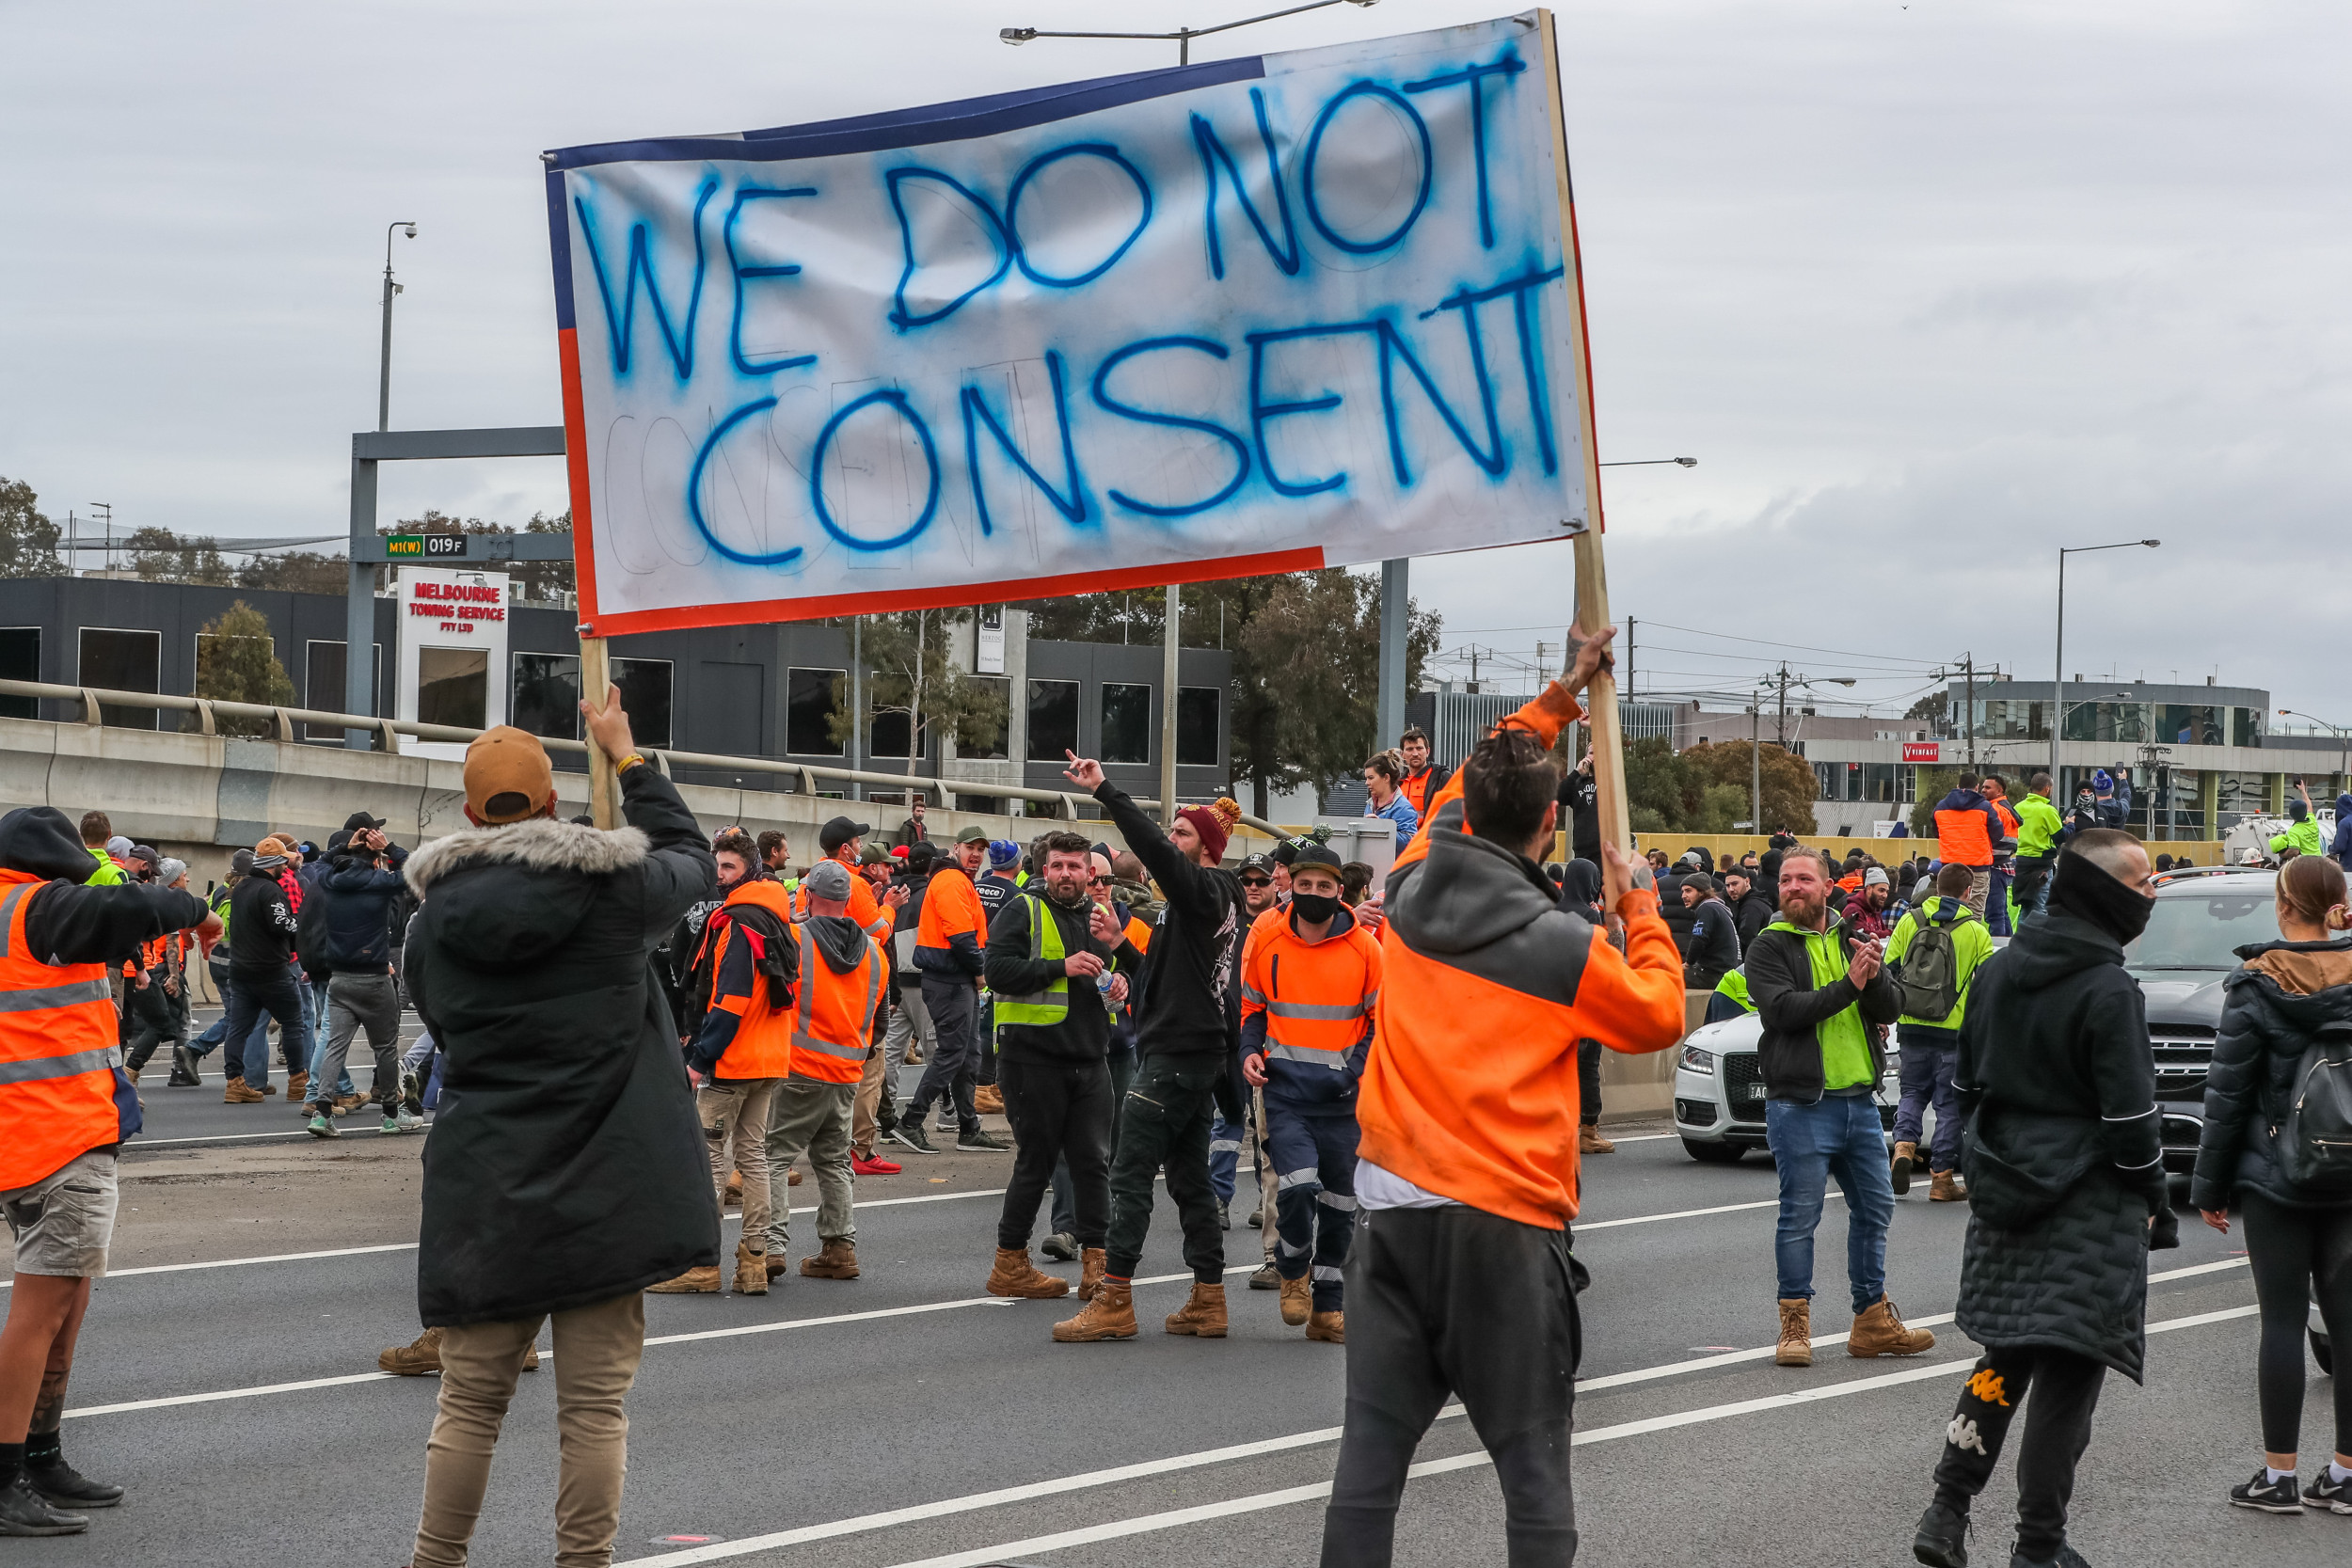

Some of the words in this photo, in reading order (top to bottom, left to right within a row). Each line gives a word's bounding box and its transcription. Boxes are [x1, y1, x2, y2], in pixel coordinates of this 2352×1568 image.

[573, 179, 818, 380] WE
[884, 142, 1154, 332] DO
[1190, 47, 1527, 280] NOT
[689, 261, 1565, 566] CONSENT
[389, 540, 421, 553] M1(W)
[415, 582, 500, 603] MELBOURNE
[409, 603, 454, 617] TOWING
[457, 605, 504, 621] SERVICE
[440, 622, 457, 631] PTY
[458, 623, 473, 633] LTD
[976, 887, 1000, 896] reece
